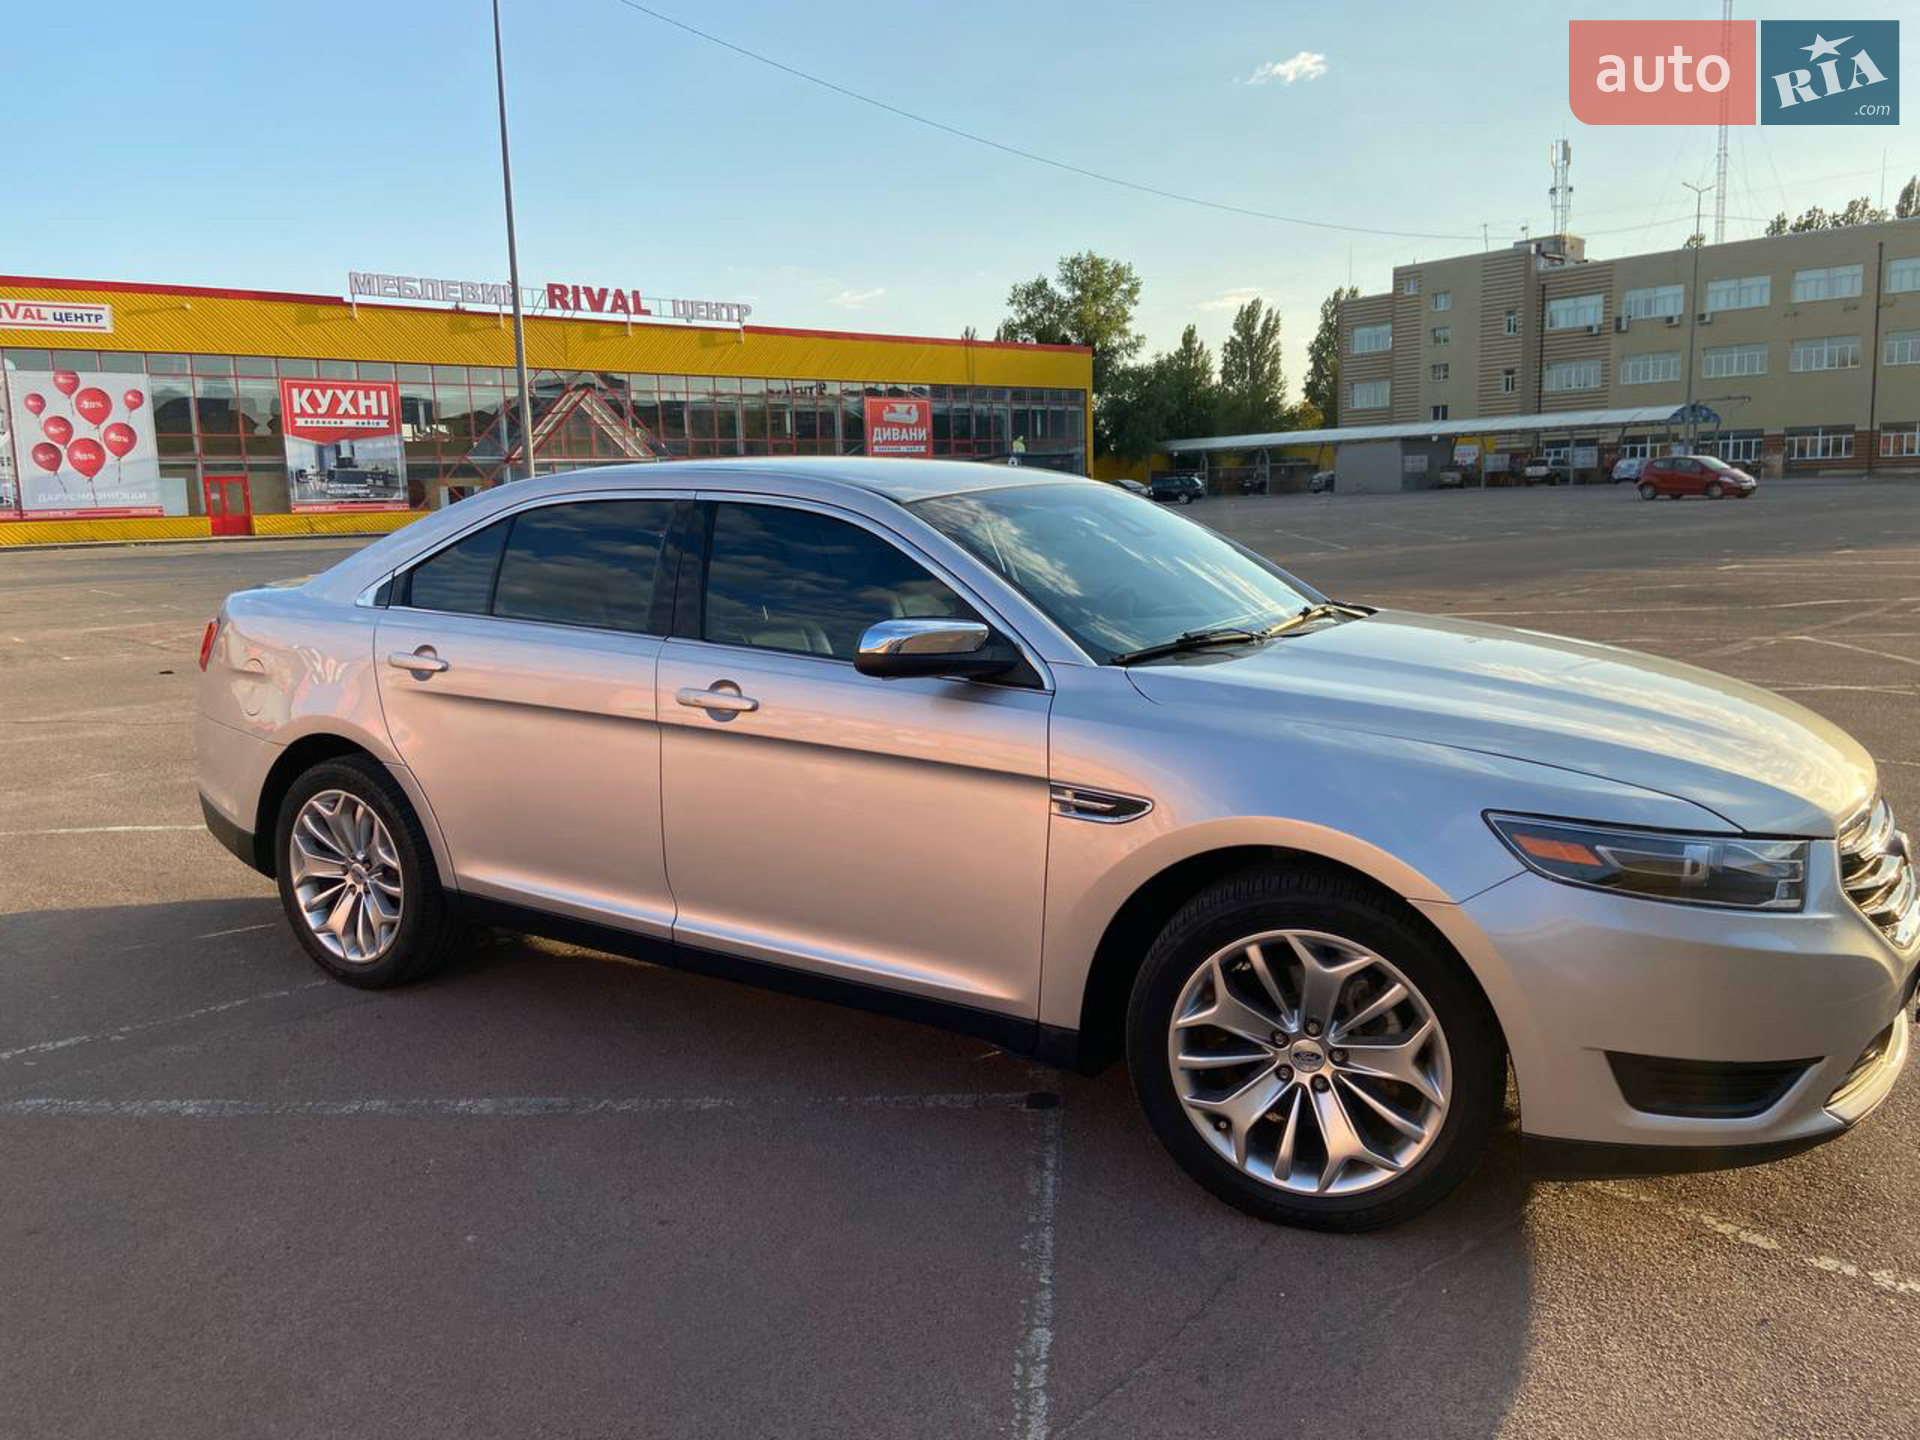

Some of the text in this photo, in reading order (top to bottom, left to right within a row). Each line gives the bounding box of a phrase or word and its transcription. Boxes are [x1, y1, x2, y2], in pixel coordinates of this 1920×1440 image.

[546, 283, 652, 316] RIVAL
[672, 299, 752, 324] ЦЕНТР
[52, 311, 104, 324] ЦЕНТР
[291, 387, 390, 416] КУХНІ
[873, 426, 927, 444] ДИВАНИ
